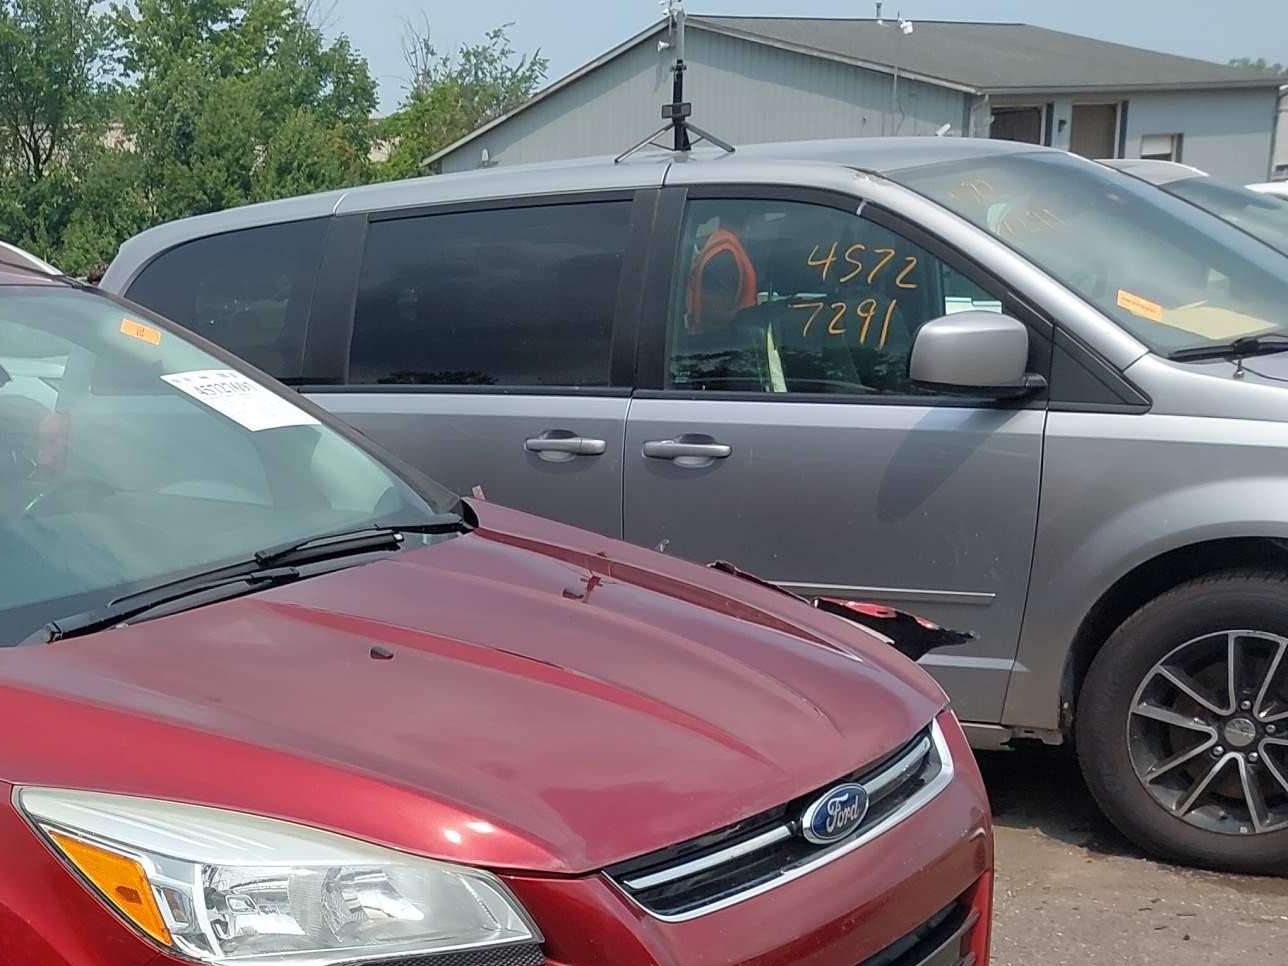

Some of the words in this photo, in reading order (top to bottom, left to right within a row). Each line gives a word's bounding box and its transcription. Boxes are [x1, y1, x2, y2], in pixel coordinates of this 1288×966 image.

[807, 240, 919, 289] 4572
[790, 298, 898, 351] 7291
[827, 793, 860, 833] Ford
